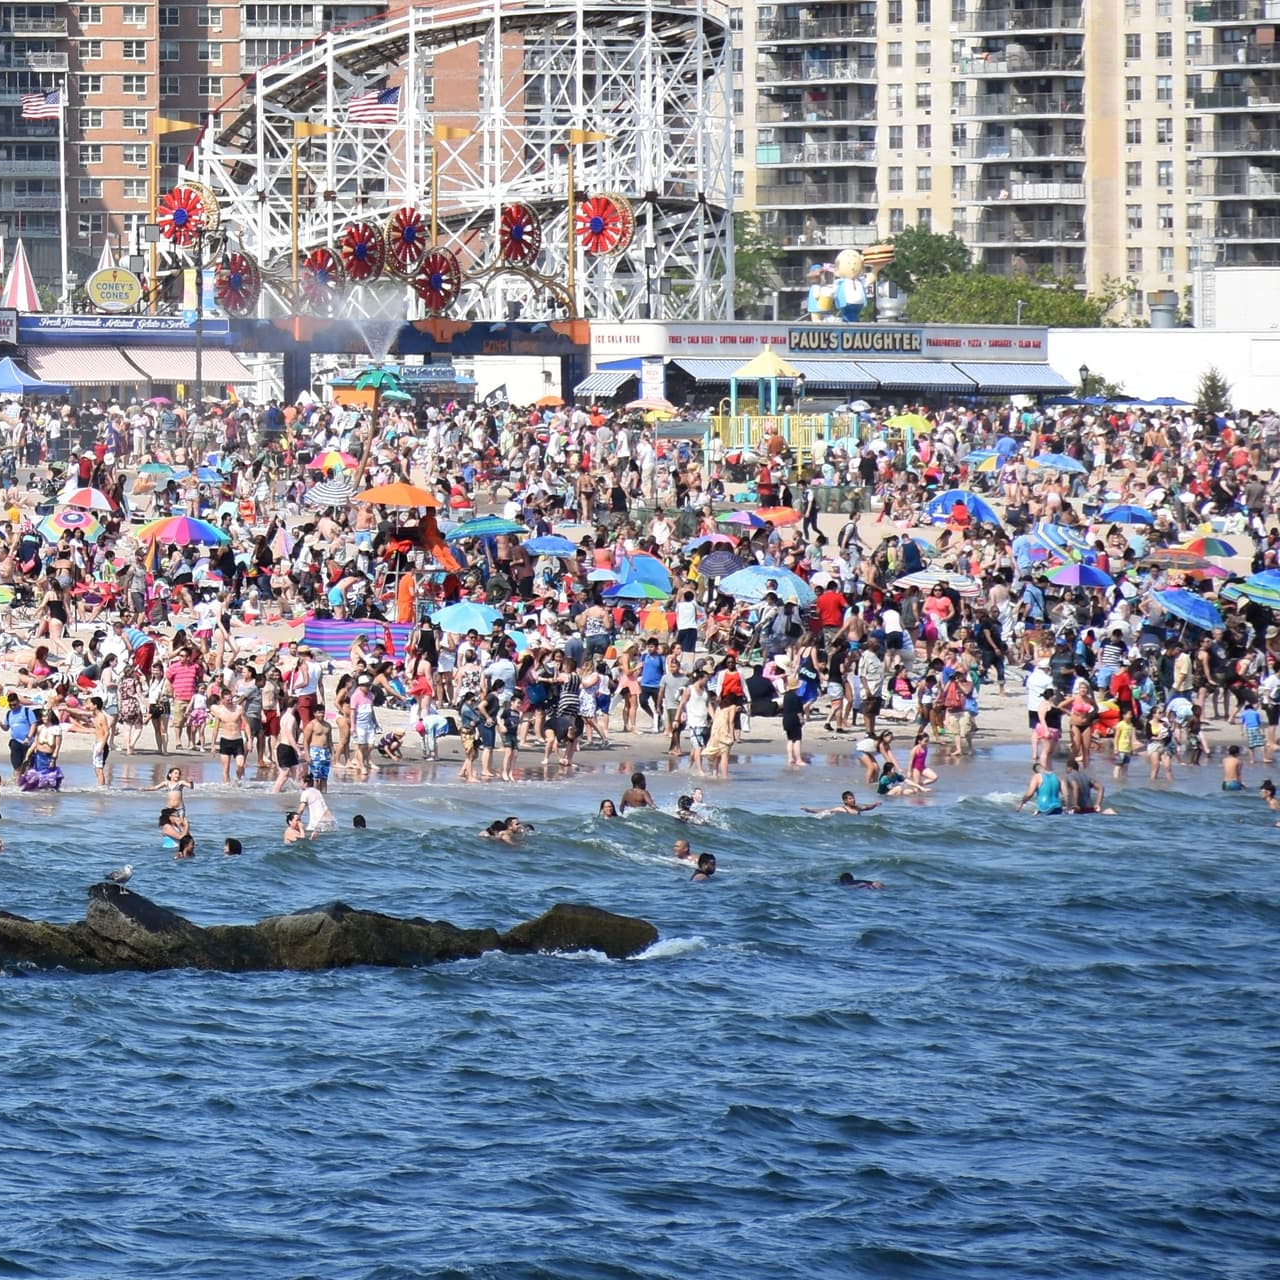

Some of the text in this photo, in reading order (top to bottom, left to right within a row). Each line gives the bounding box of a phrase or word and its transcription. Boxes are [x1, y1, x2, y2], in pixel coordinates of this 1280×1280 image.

[96, 282, 134, 291] CONEY'S
[100, 291, 130, 300] CONES
[791, 331, 921, 352] PAUL'S DAUGHTER
